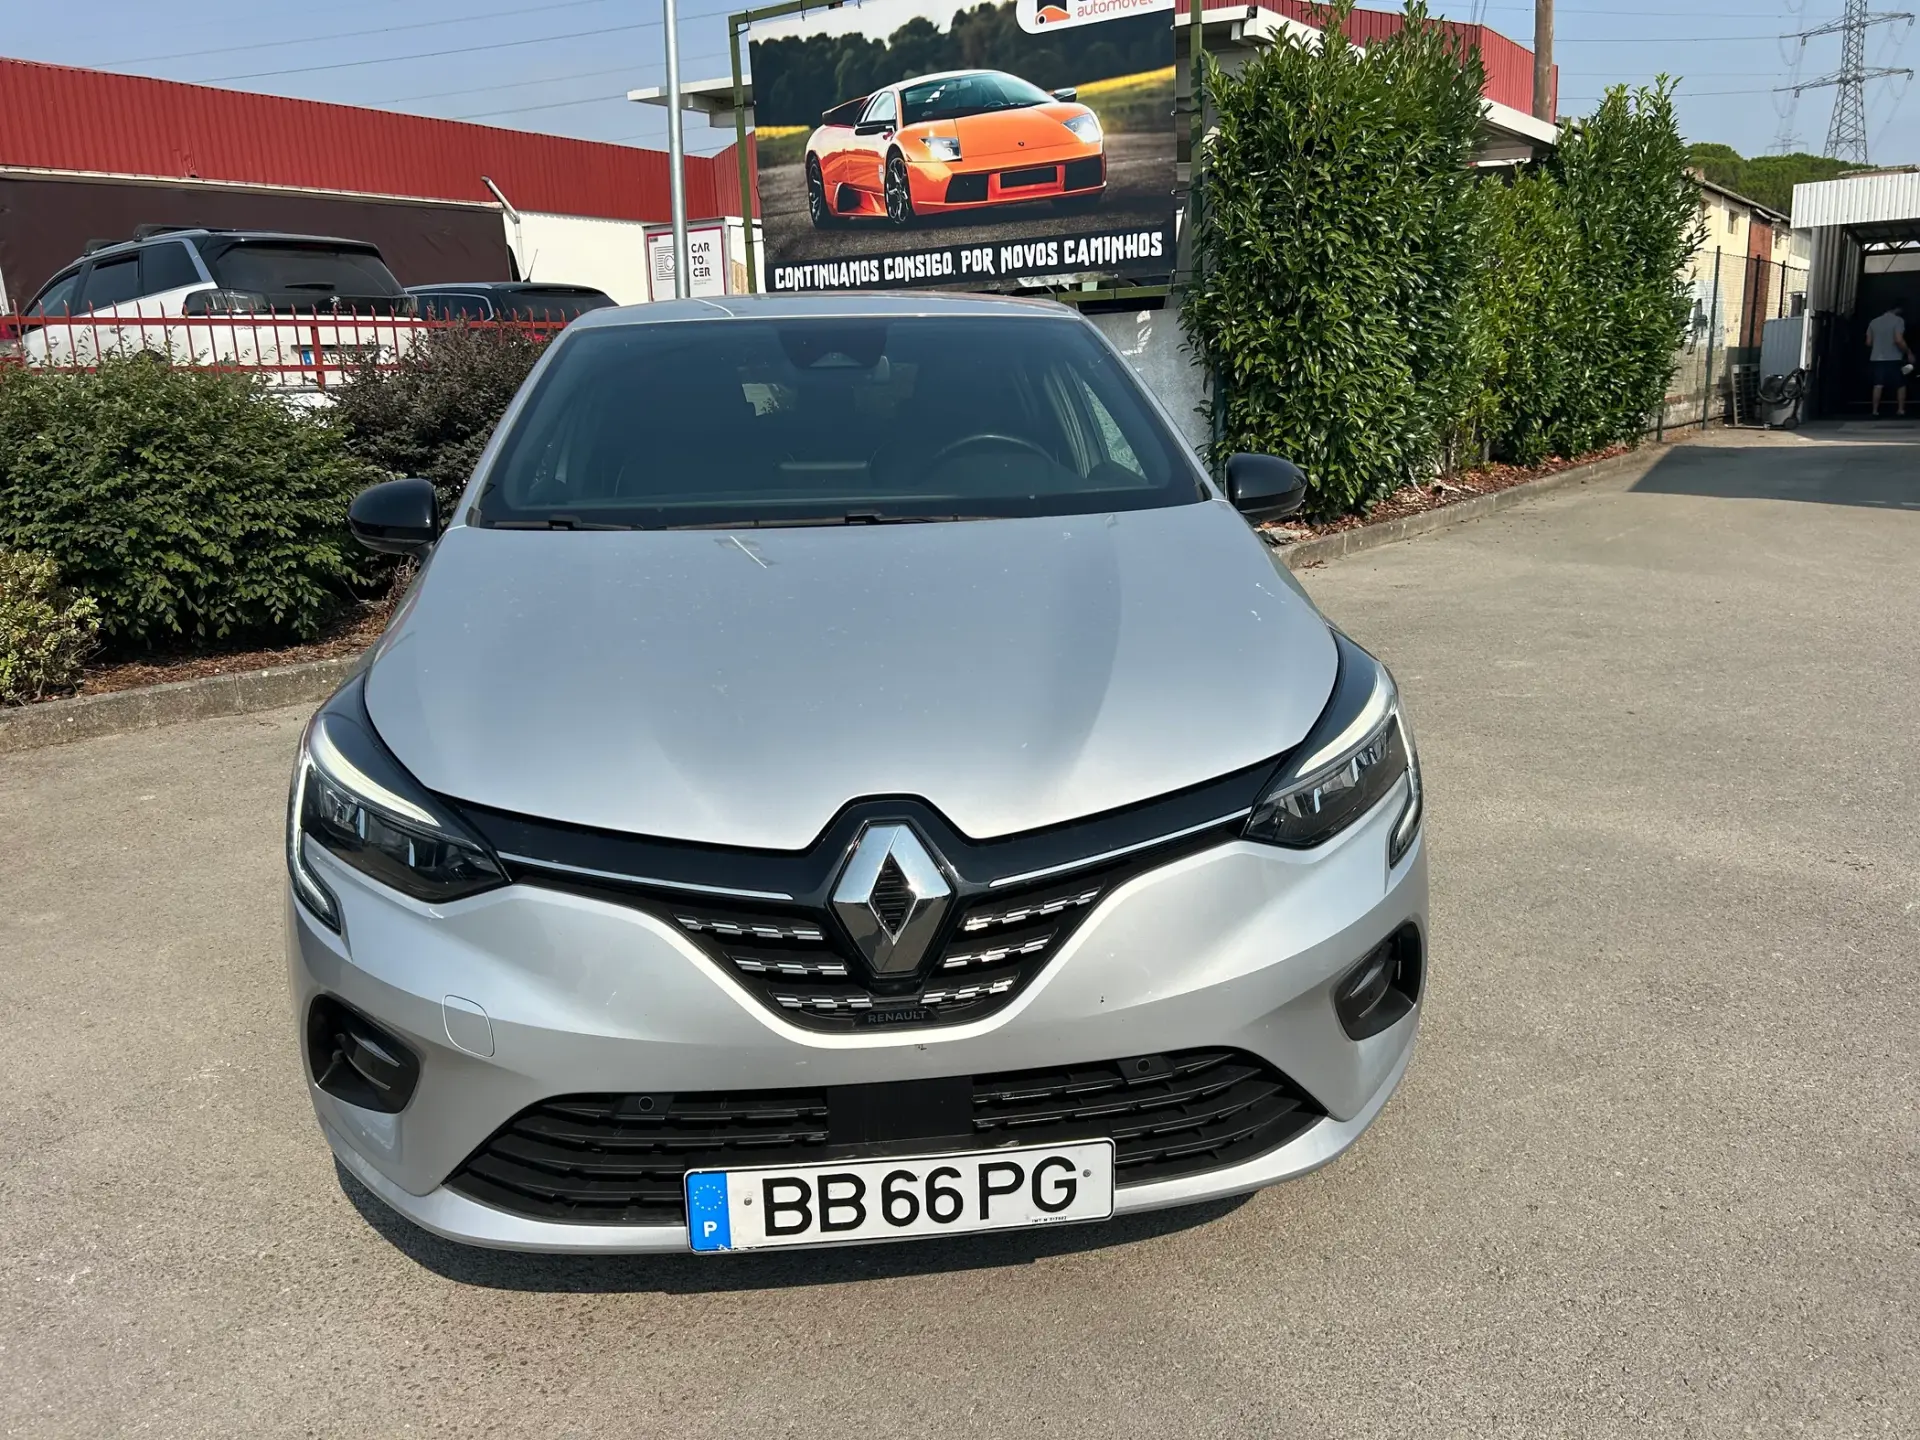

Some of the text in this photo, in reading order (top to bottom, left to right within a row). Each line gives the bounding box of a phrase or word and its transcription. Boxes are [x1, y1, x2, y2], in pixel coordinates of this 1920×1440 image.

[691, 242, 710, 253] CAR
[691, 255, 704, 265] TO
[774, 231, 1163, 291] CONTINUAMOS CONSIGO, POR NOVOS CAMINHOS
[692, 267, 711, 277] CER
[868, 1010, 927, 1023] RENAULT
[762, 1156, 1077, 1237] BB 66 PG
[703, 1220, 718, 1238] P
